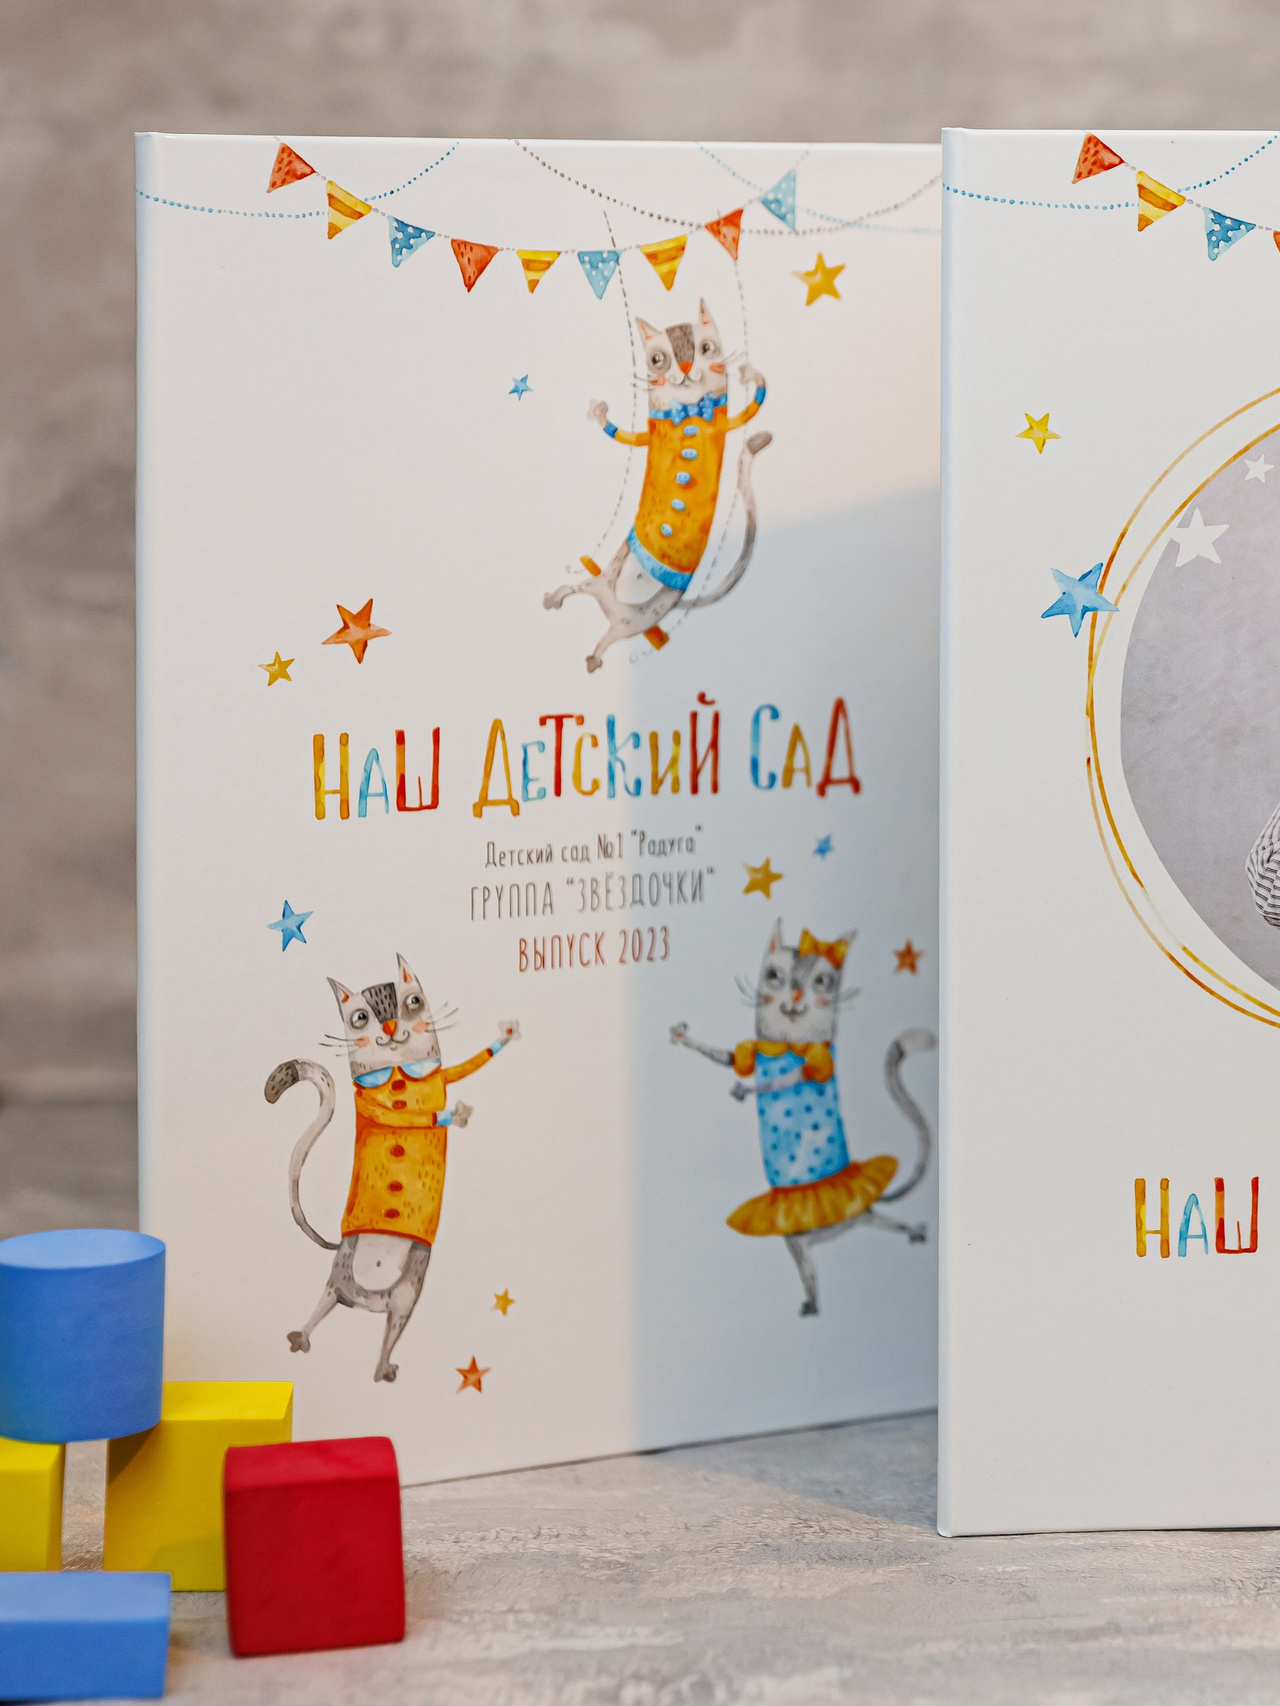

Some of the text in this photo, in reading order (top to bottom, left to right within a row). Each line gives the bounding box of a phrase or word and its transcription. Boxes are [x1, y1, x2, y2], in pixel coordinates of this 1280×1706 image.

[485, 841, 555, 869] Детский
[561, 842, 590, 864] сад
[597, 832, 624, 859] №1
[469, 880, 556, 922] ГРУППА
[517, 925, 671, 974] ВЫПУСК 2023
